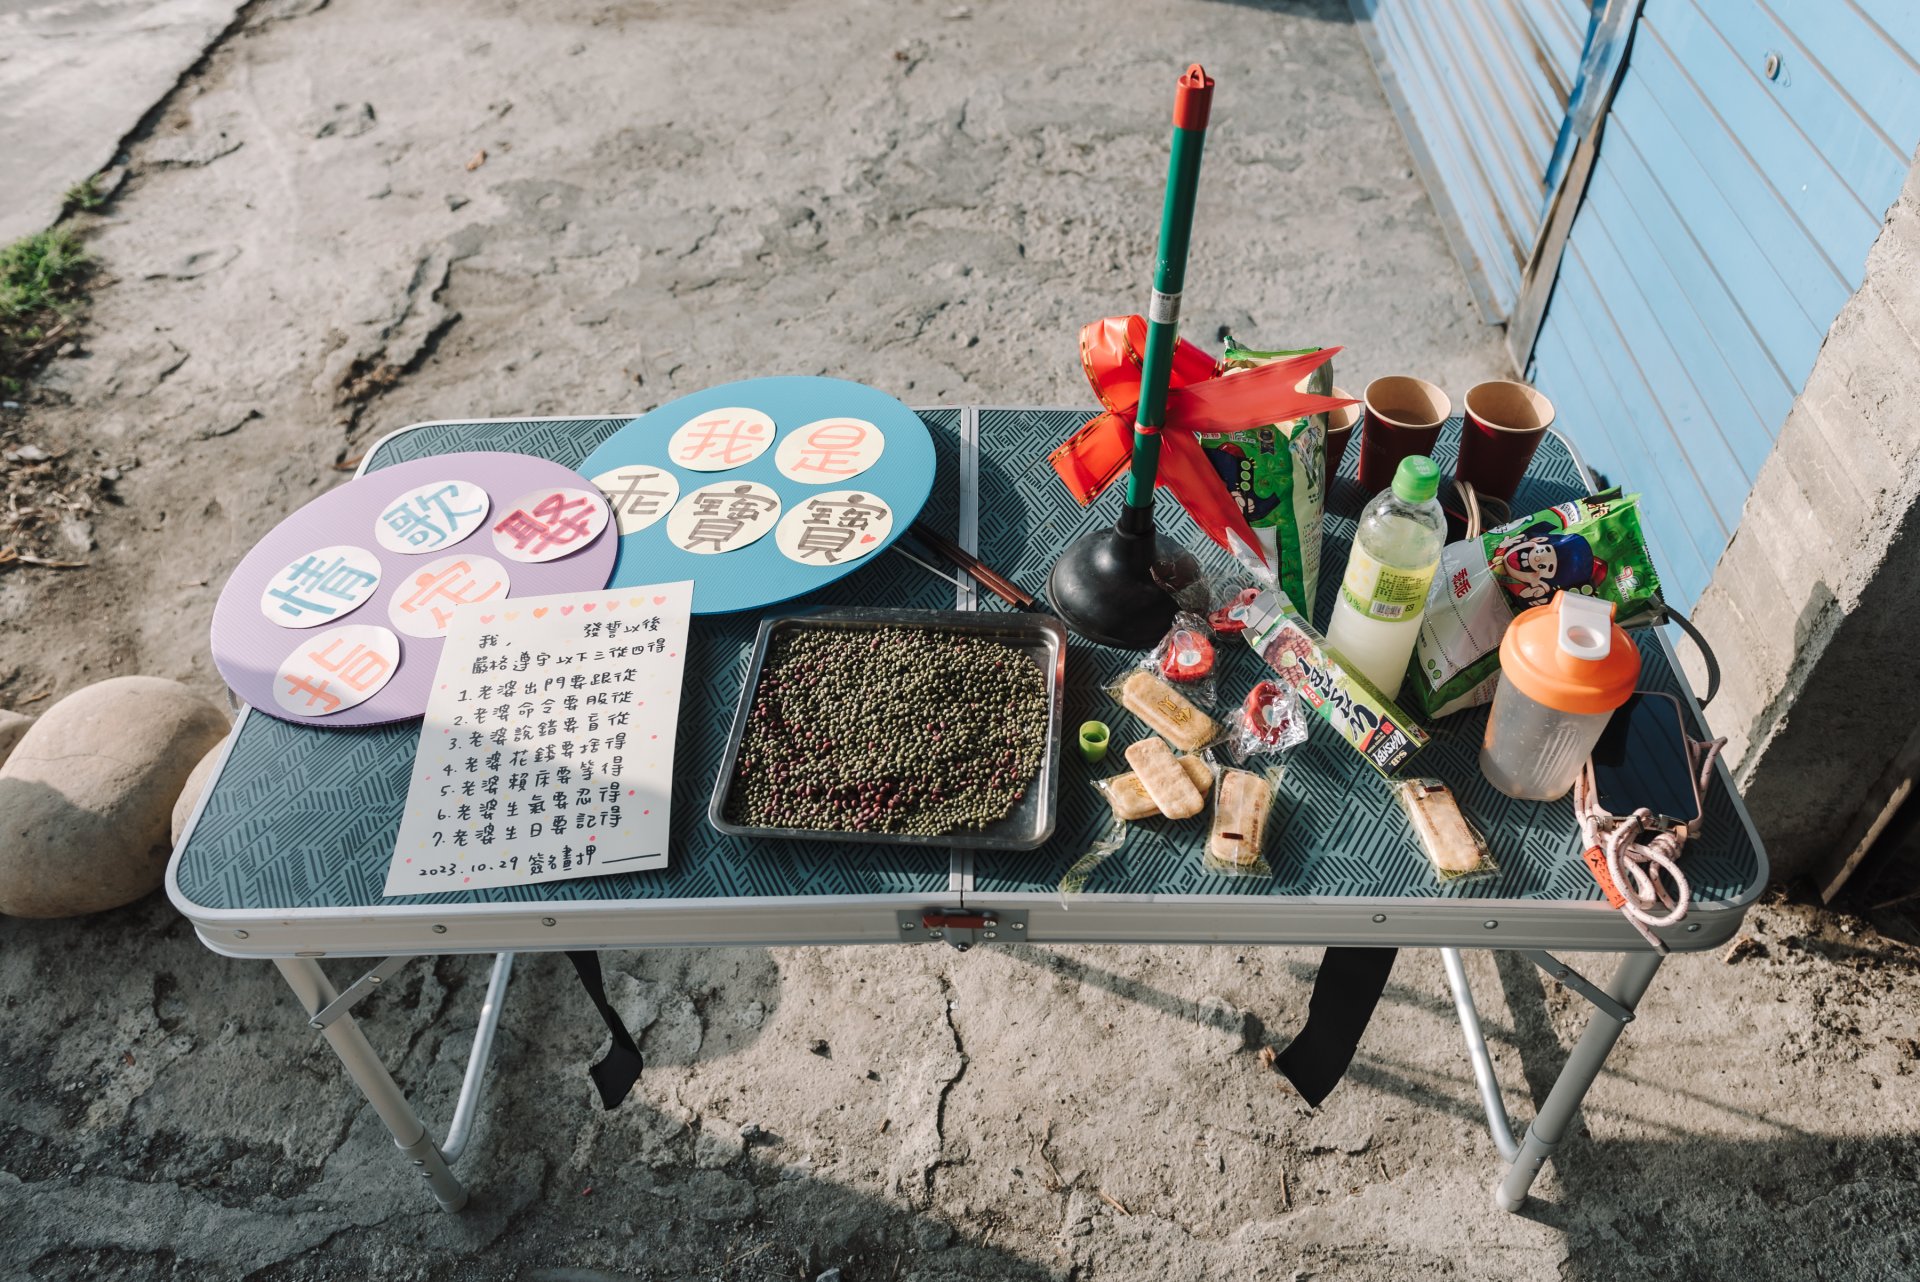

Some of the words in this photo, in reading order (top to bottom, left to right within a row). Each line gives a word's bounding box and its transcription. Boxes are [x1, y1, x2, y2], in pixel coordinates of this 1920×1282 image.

[680, 419, 867, 475] 我是
[583, 616, 661, 639] 發誓以後
[472, 637, 666, 675] 嚴格遵守以下三從四得
[1297, 656, 1381, 743] WASABI
[1303, 685, 1323, 706] HOT
[1371, 728, 1409, 767] WASABI
[419, 856, 518, 876] 2023.10.29
[528, 845, 596, 876] 簽名畫押
